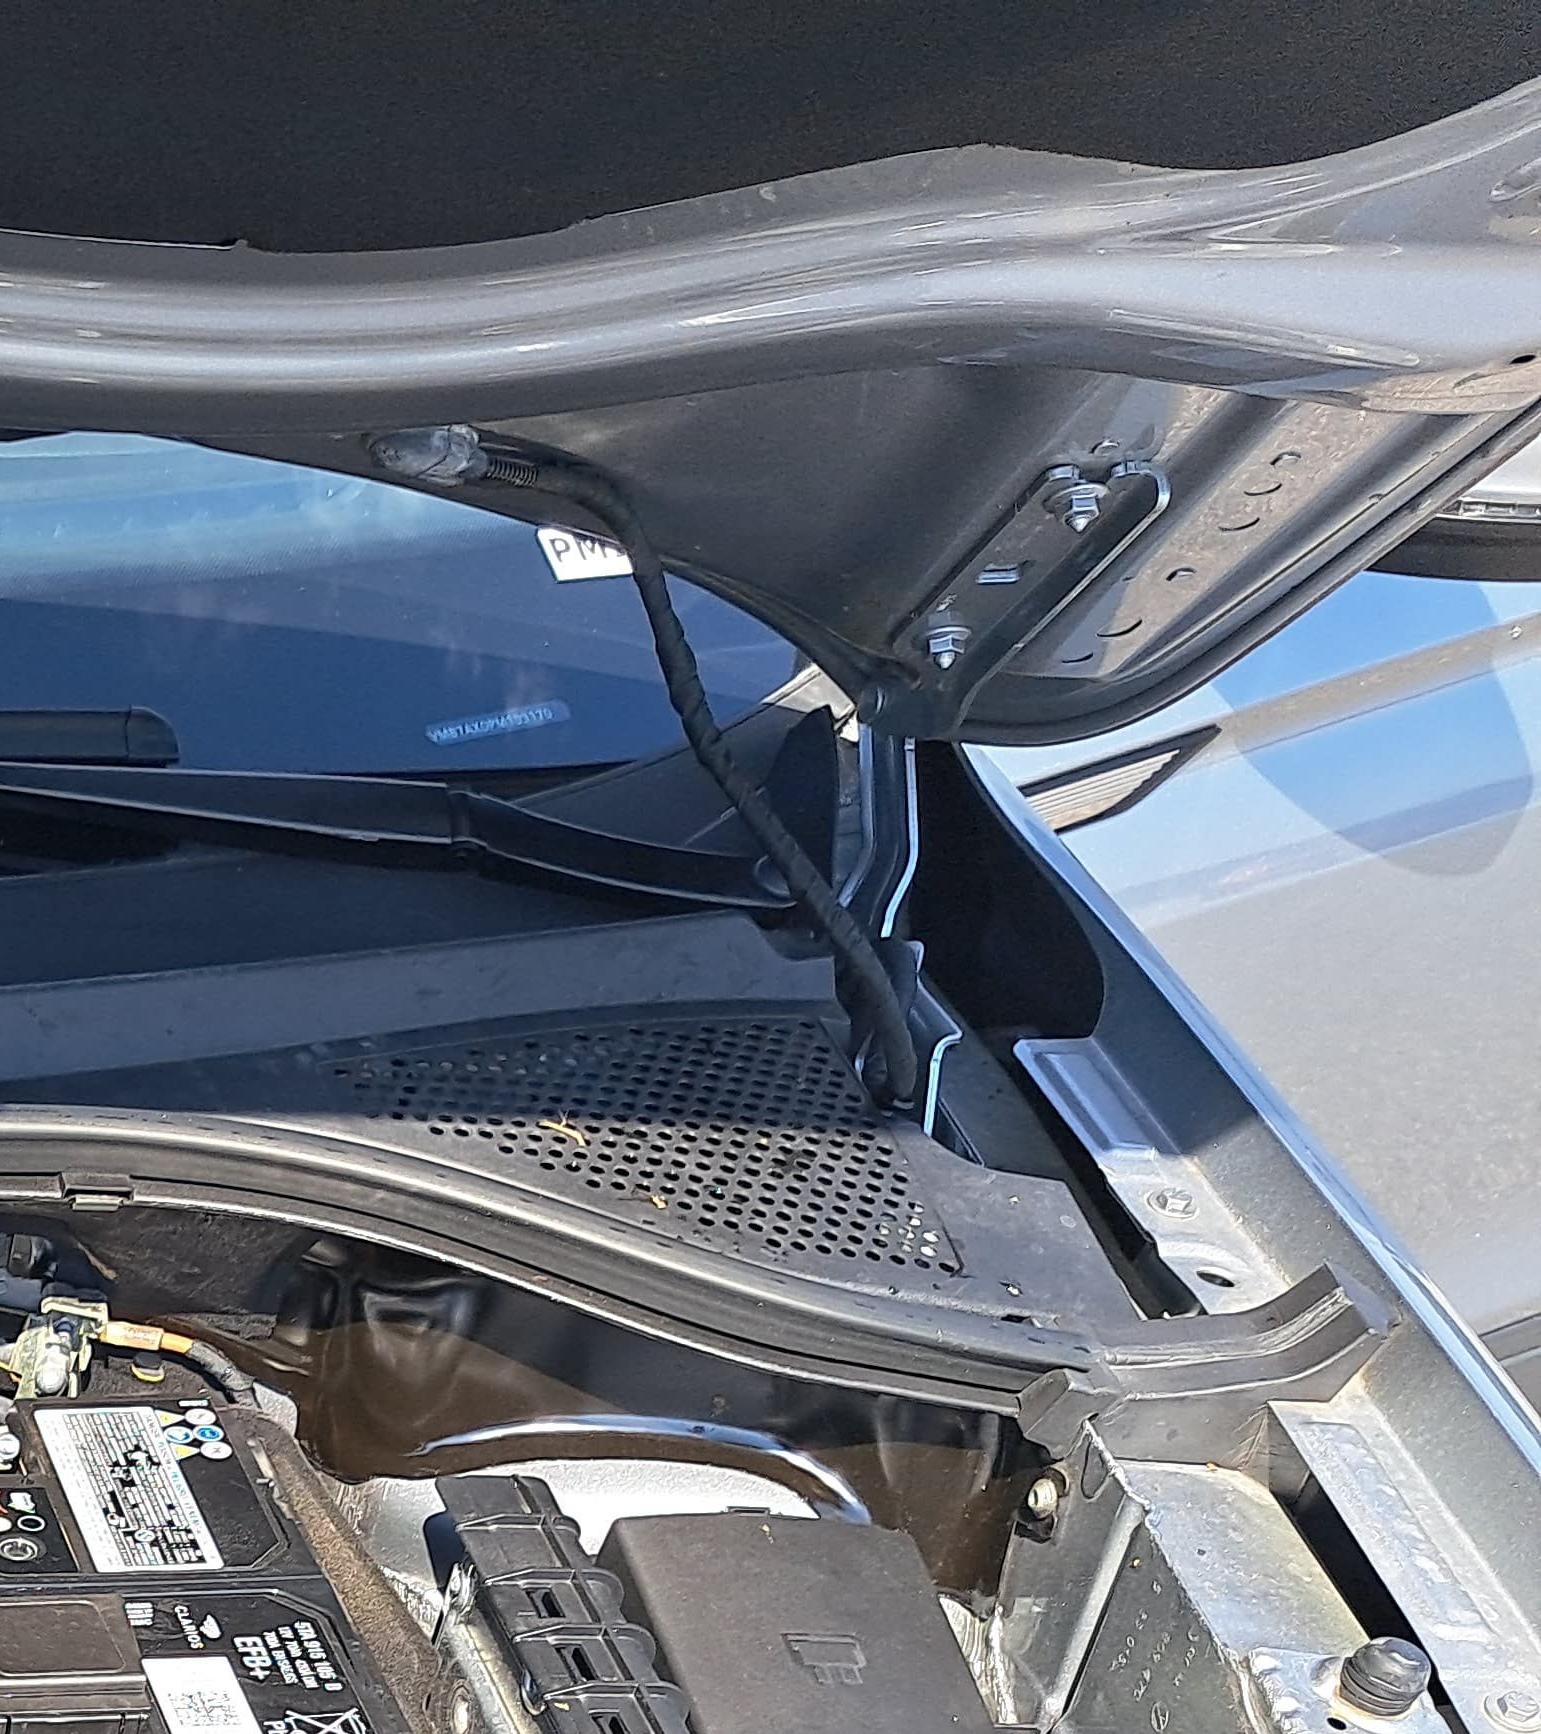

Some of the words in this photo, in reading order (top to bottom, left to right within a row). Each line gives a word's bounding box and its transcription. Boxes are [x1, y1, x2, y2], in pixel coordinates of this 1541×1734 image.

[174, 1605, 205, 1649] CLARIOS
[295, 1620, 317, 1640] 5TA
[233, 1636, 272, 1680] EFB+
[304, 1640, 326, 1660] 915
